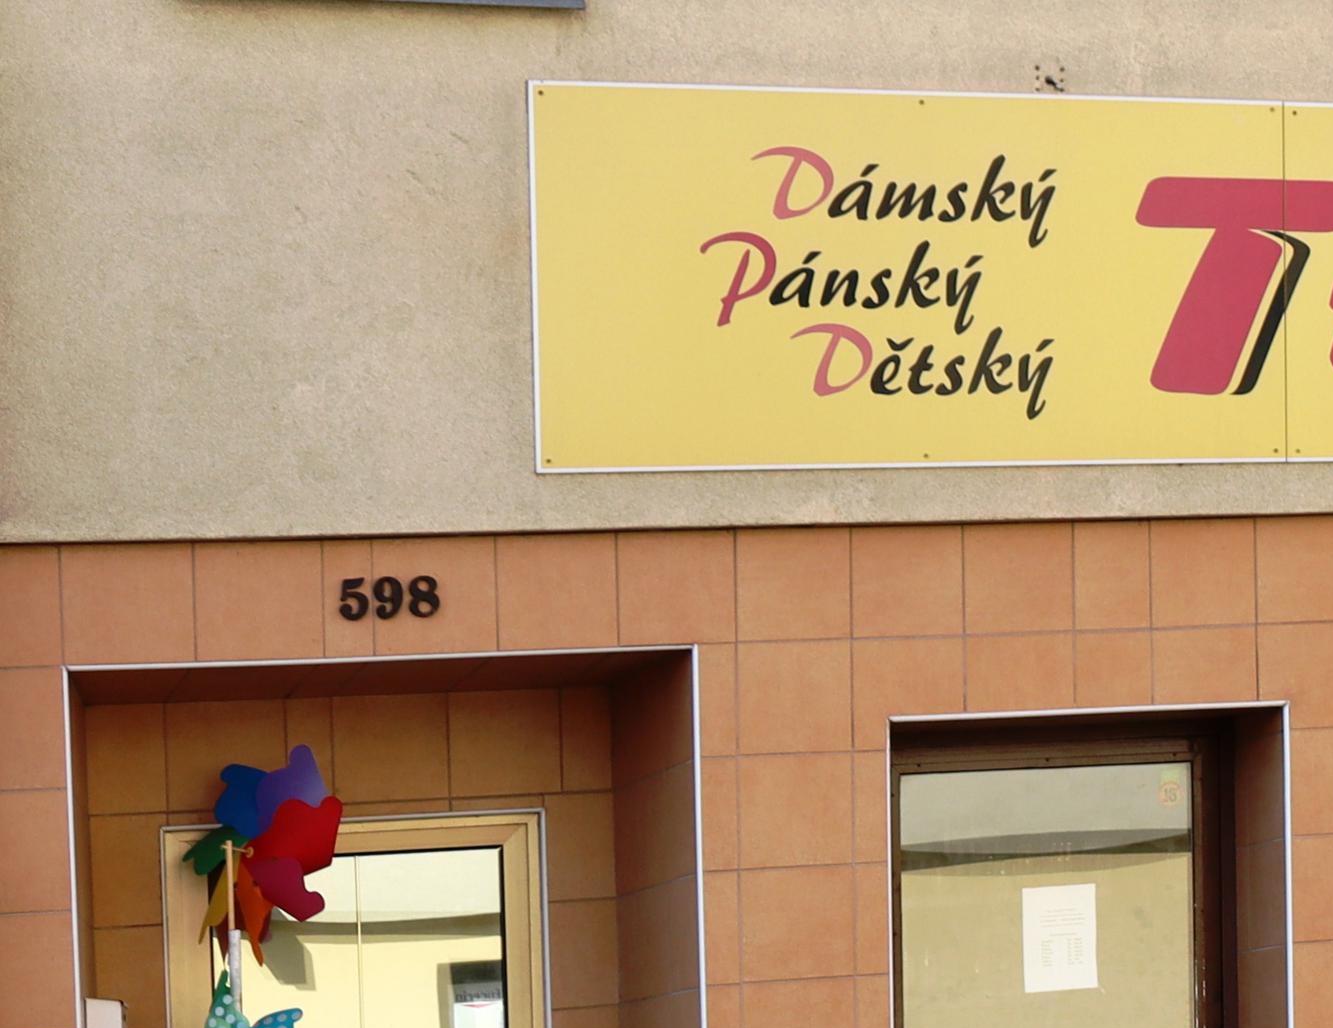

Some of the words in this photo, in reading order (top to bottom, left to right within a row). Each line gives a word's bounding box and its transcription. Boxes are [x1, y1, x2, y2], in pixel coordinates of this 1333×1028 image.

[751, 146, 1057, 248] Dámský
[700, 231, 983, 335] Pánský
[791, 322, 1055, 420] Dětský
[339, 575, 440, 621] 598
